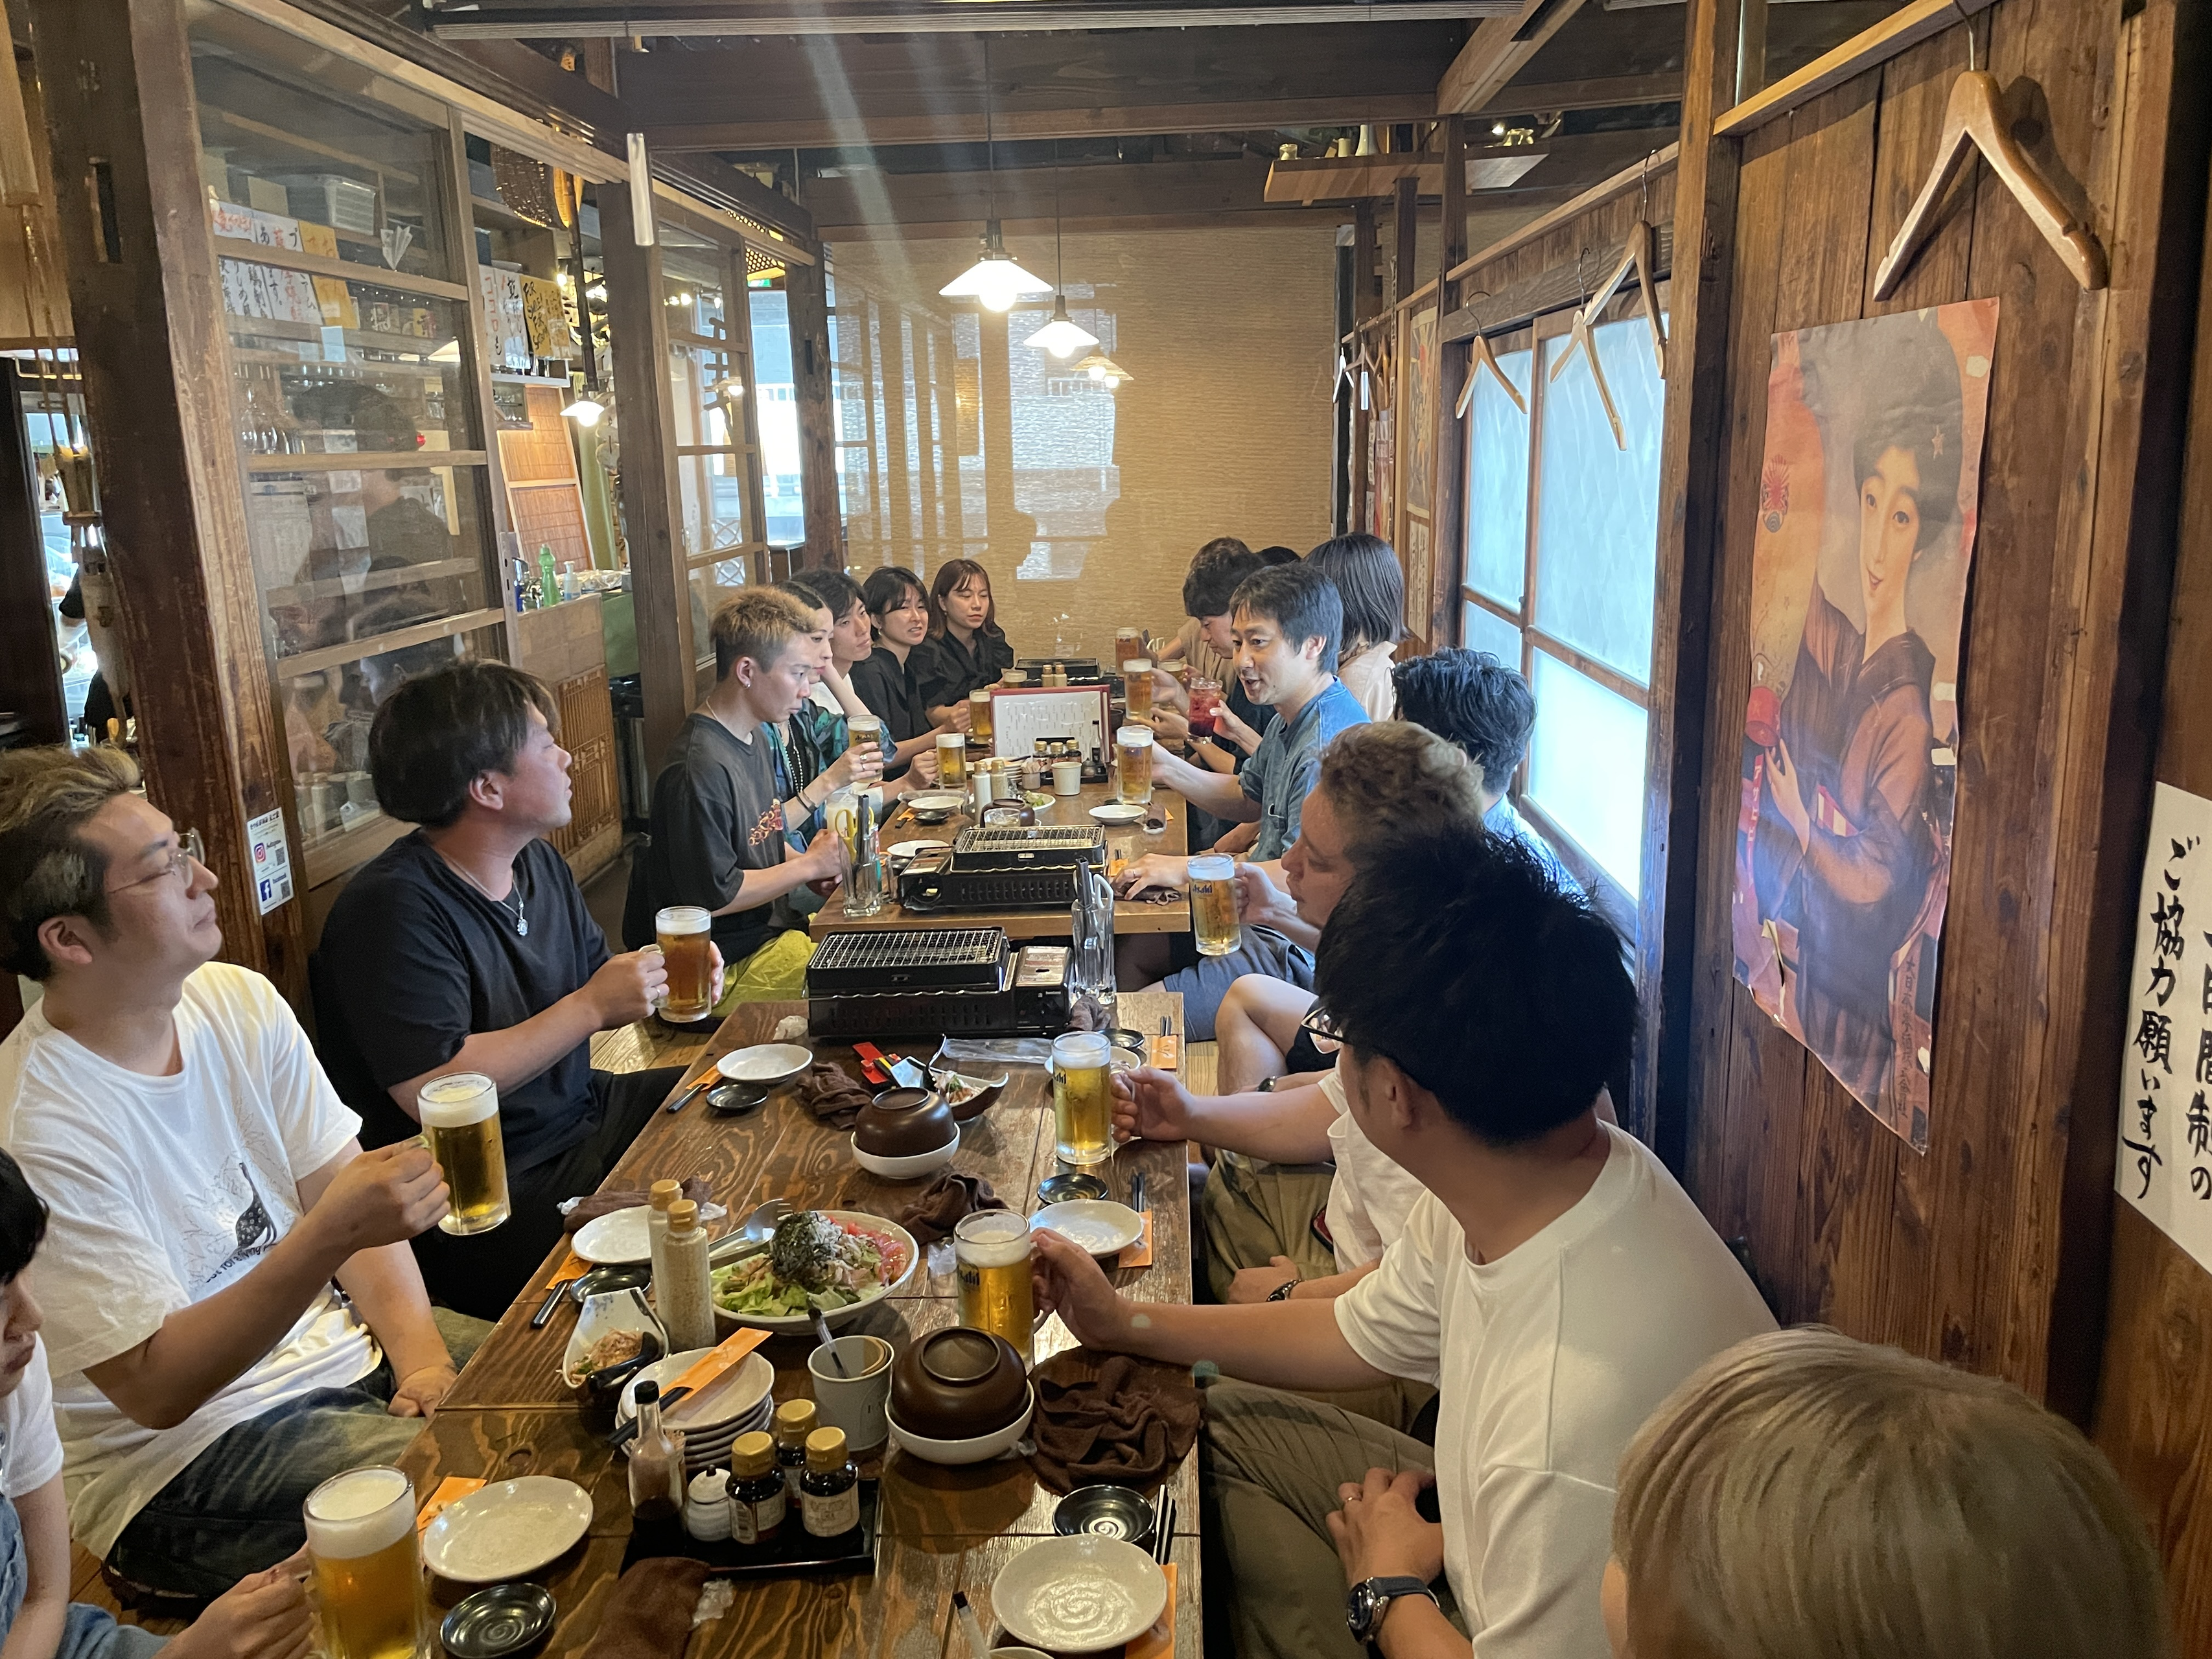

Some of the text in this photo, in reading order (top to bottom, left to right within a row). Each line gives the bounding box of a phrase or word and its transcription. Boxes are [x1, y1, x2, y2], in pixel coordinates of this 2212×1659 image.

[2122, 835, 2200, 1200] ご協力願います
